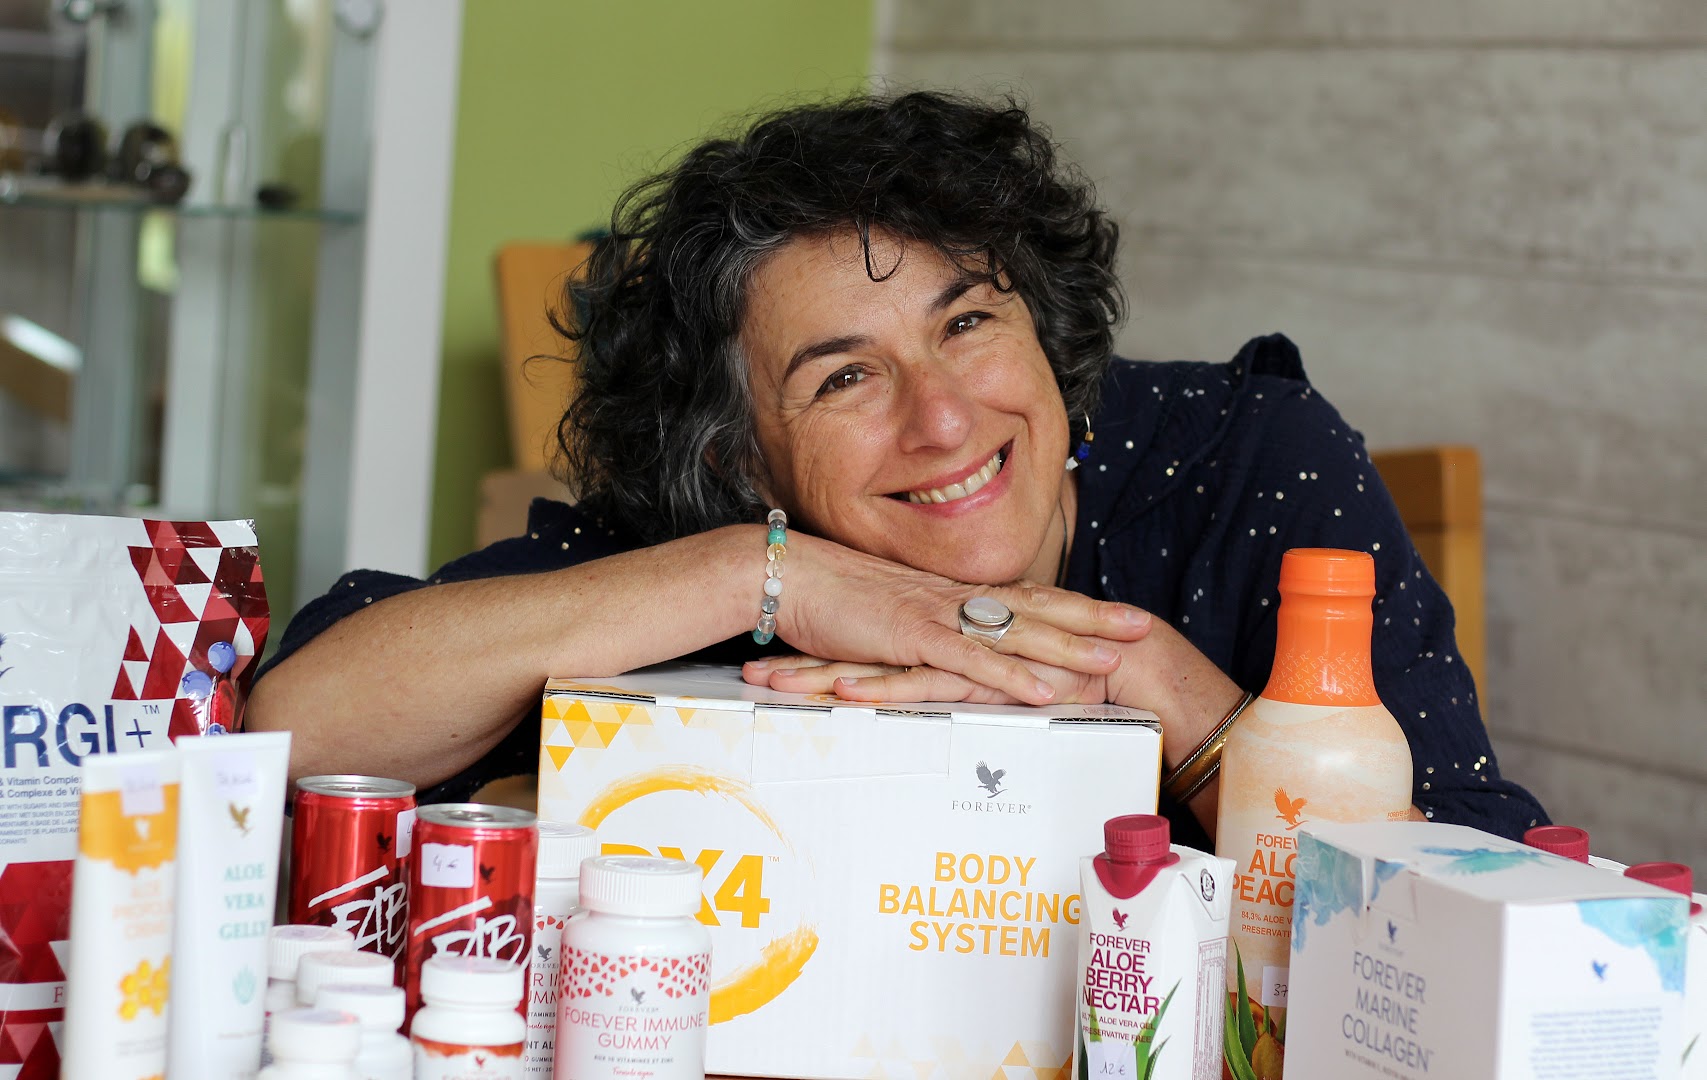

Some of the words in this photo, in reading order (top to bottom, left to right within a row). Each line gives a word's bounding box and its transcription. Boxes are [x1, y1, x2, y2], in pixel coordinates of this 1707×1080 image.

[7, 777, 41, 786] Vitamin
[43, 776, 82, 785] Comple
[8, 789, 53, 798] Complexe
[56, 788, 67, 796] de
[224, 864, 266, 881] ALOE
[934, 851, 1037, 887] BODY
[224, 893, 266, 909] VERA
[878, 883, 1081, 925] BALANCING
[1263, 914, 1285, 925] ALOE
[219, 921, 268, 940] GELLY
[908, 920, 1051, 958] SYSTEM
[1241, 923, 1293, 938] PRESERVATI
[1089, 932, 1151, 953] FOREVER
[1091, 948, 1146, 974] ALOE
[1086, 966, 1154, 994] BERRY
[1353, 951, 1426, 1004] FOREVER
[1273, 983, 1289, 997] 37
[564, 1005, 637, 1032] FOREVER
[1356, 986, 1418, 1035] MARINE
[1099, 1016, 1117, 1026] ALOE
[1118, 1018, 1138, 1029] VERA
[1139, 1021, 1155, 1031] GEL
[597, 1032, 672, 1051] GUMMY
[1082, 1025, 1129, 1041] PRESERVATIVE
[1131, 1033, 1151, 1043] FREE
[1100, 1061, 1115, 1075] 12
